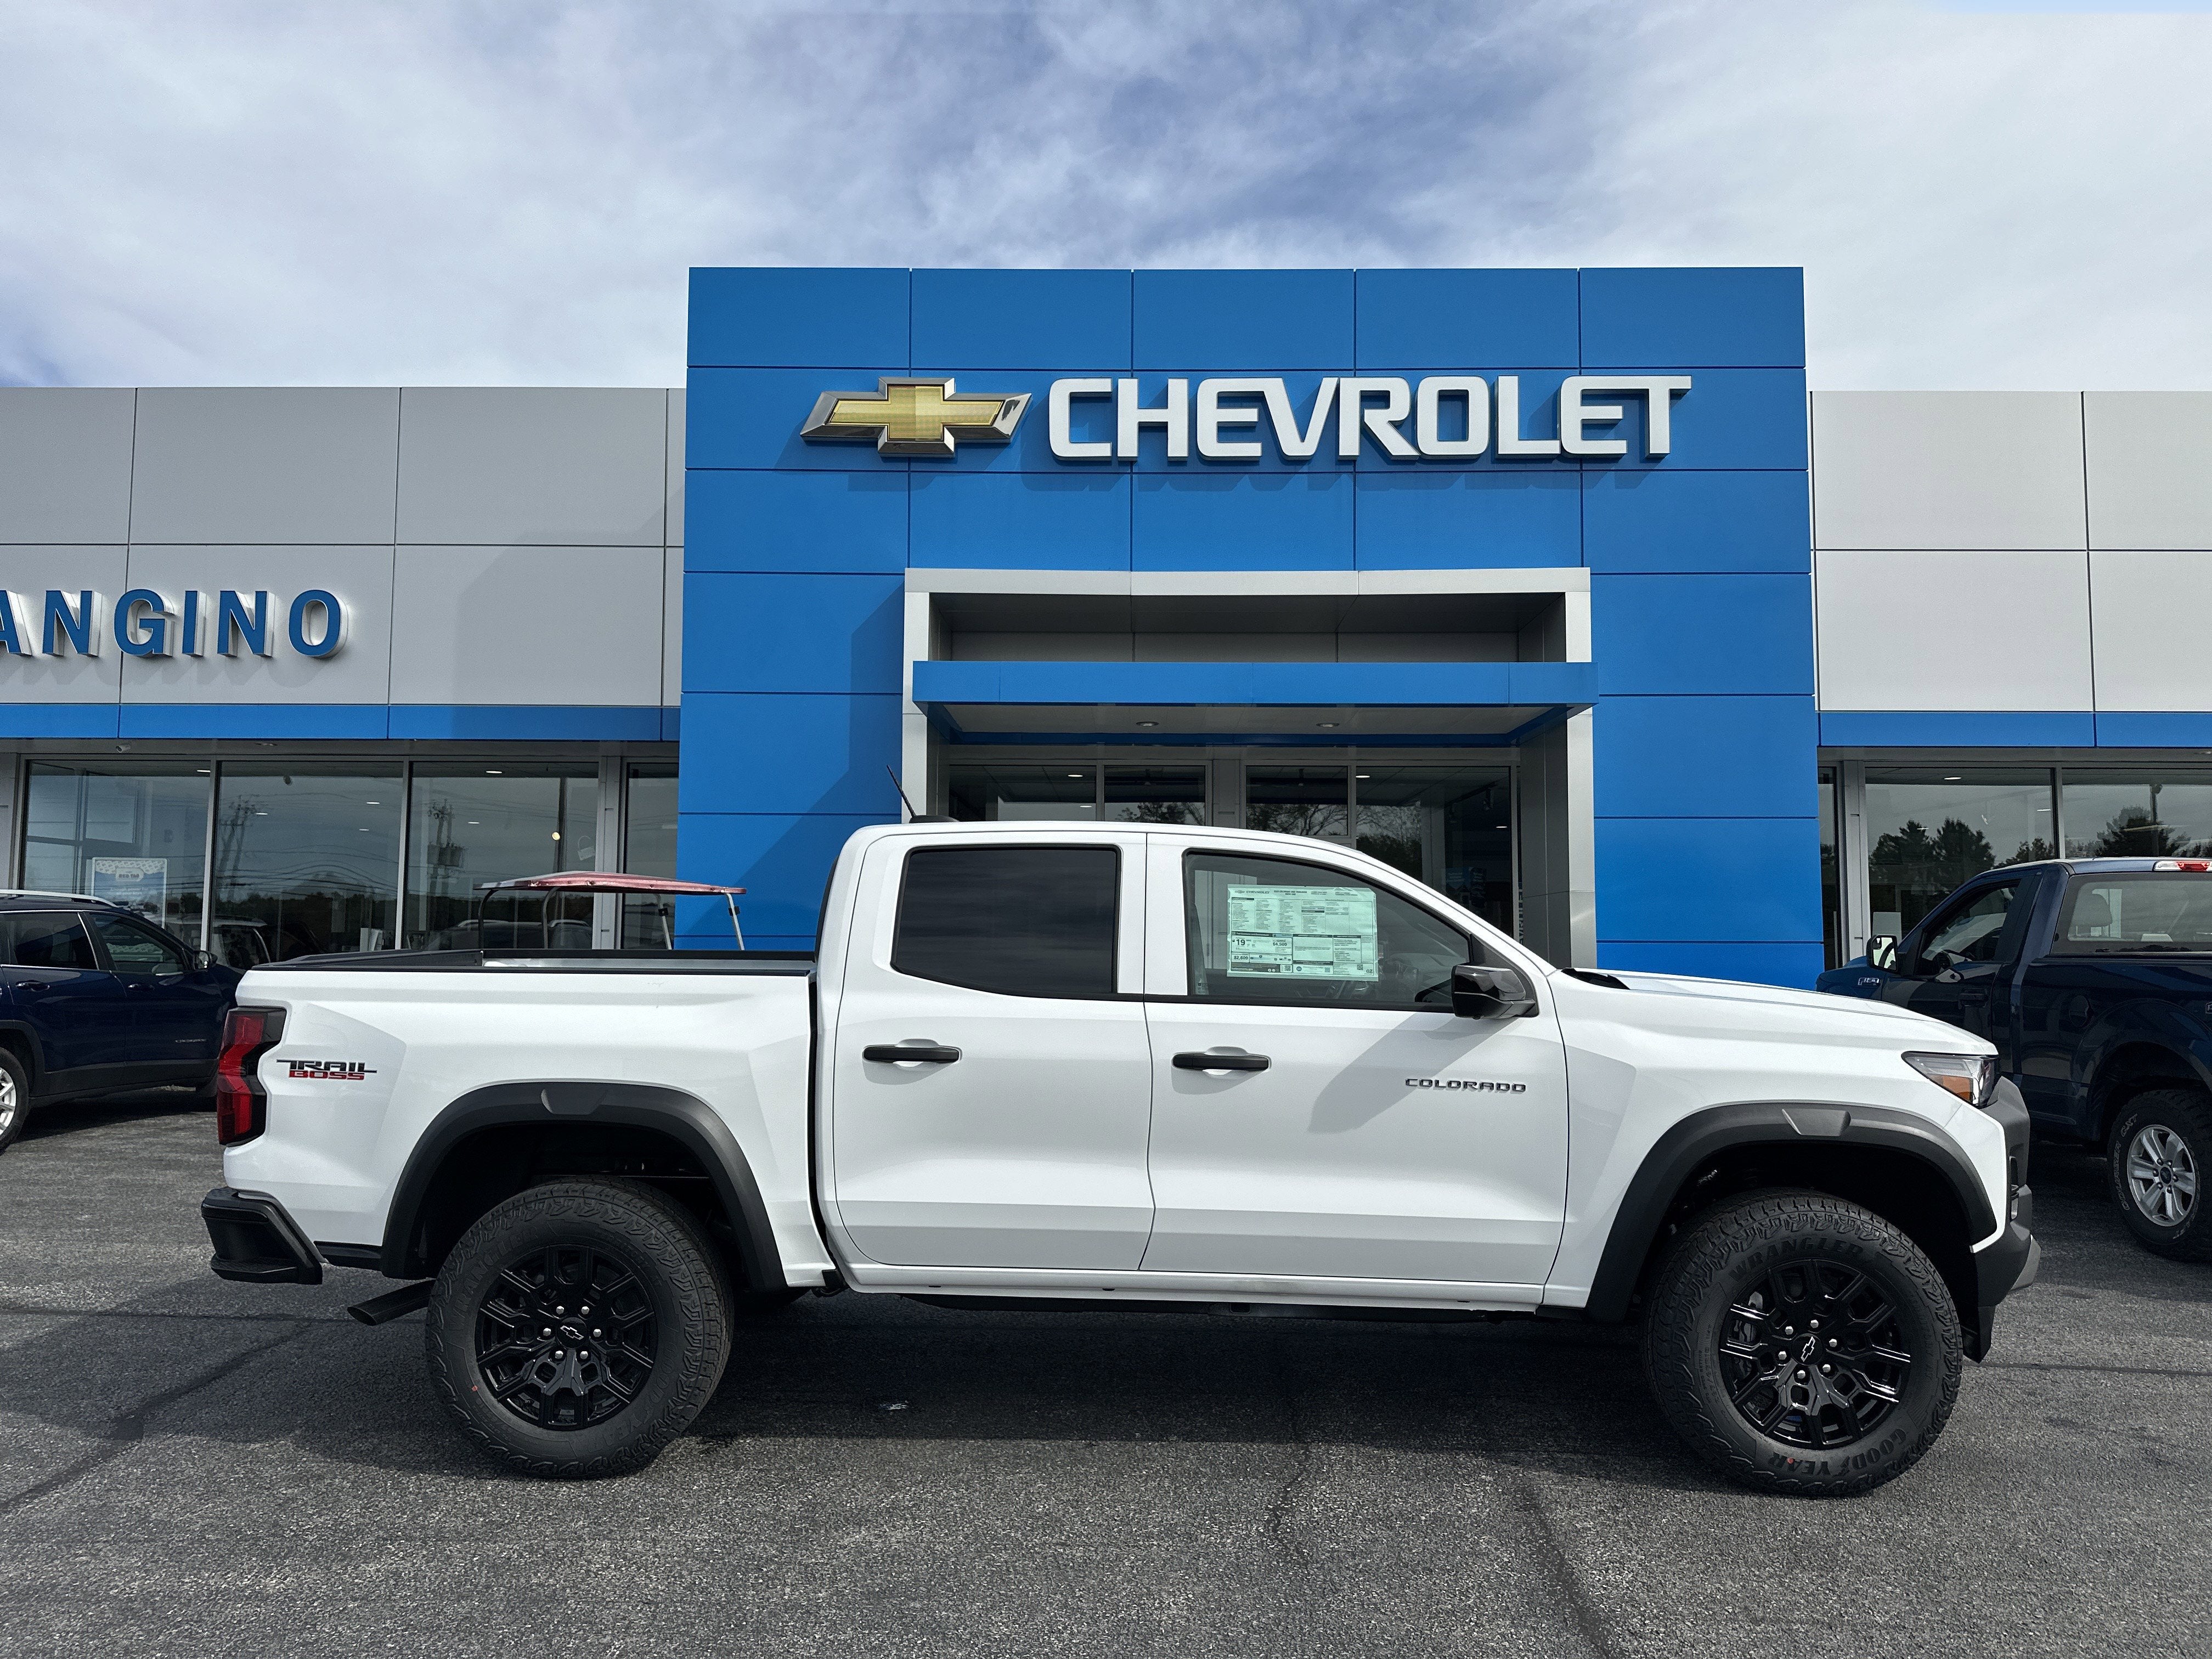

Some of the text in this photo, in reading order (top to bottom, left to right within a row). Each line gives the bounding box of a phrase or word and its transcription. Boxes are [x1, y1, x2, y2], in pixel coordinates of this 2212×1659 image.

[1048, 375, 1692, 459] CHEVROLET
[276, 1059, 377, 1074] TRAIL
[289, 1070, 365, 1081] BOSS
[1405, 1078, 1526, 1092] COLORADO
[2113, 1113, 2138, 1211] COURSER CXT
[1729, 1238, 1865, 1282] WRANGLER
[1768, 1427, 1908, 1477] GOODYEAR
